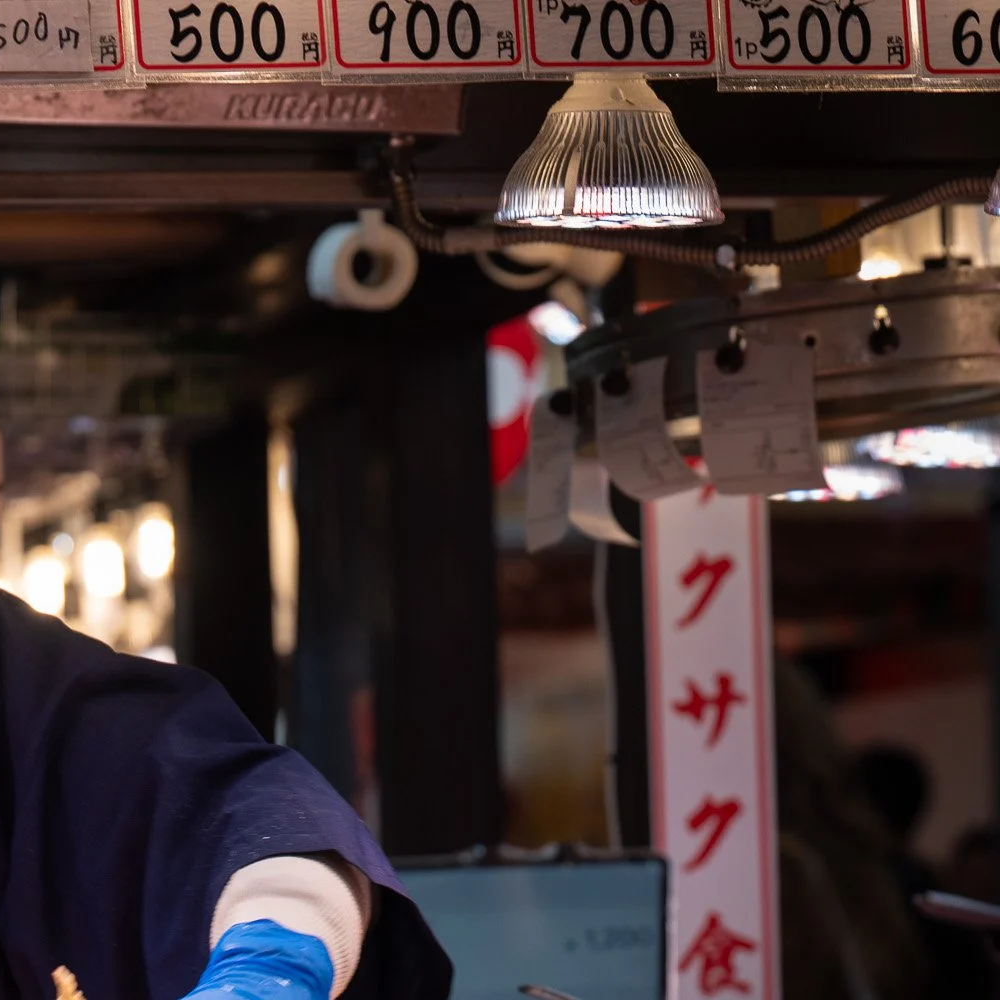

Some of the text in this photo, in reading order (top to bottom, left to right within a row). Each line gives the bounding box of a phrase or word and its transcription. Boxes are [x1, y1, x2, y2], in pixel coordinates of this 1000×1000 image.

[170, 2, 285, 62] 500
[368, 1, 480, 61] 900
[560, 0, 674, 60] 700
[735, 36, 758, 60] 1p
[758, 5, 871, 64] 500
[672, 482, 757, 996] クサク食
